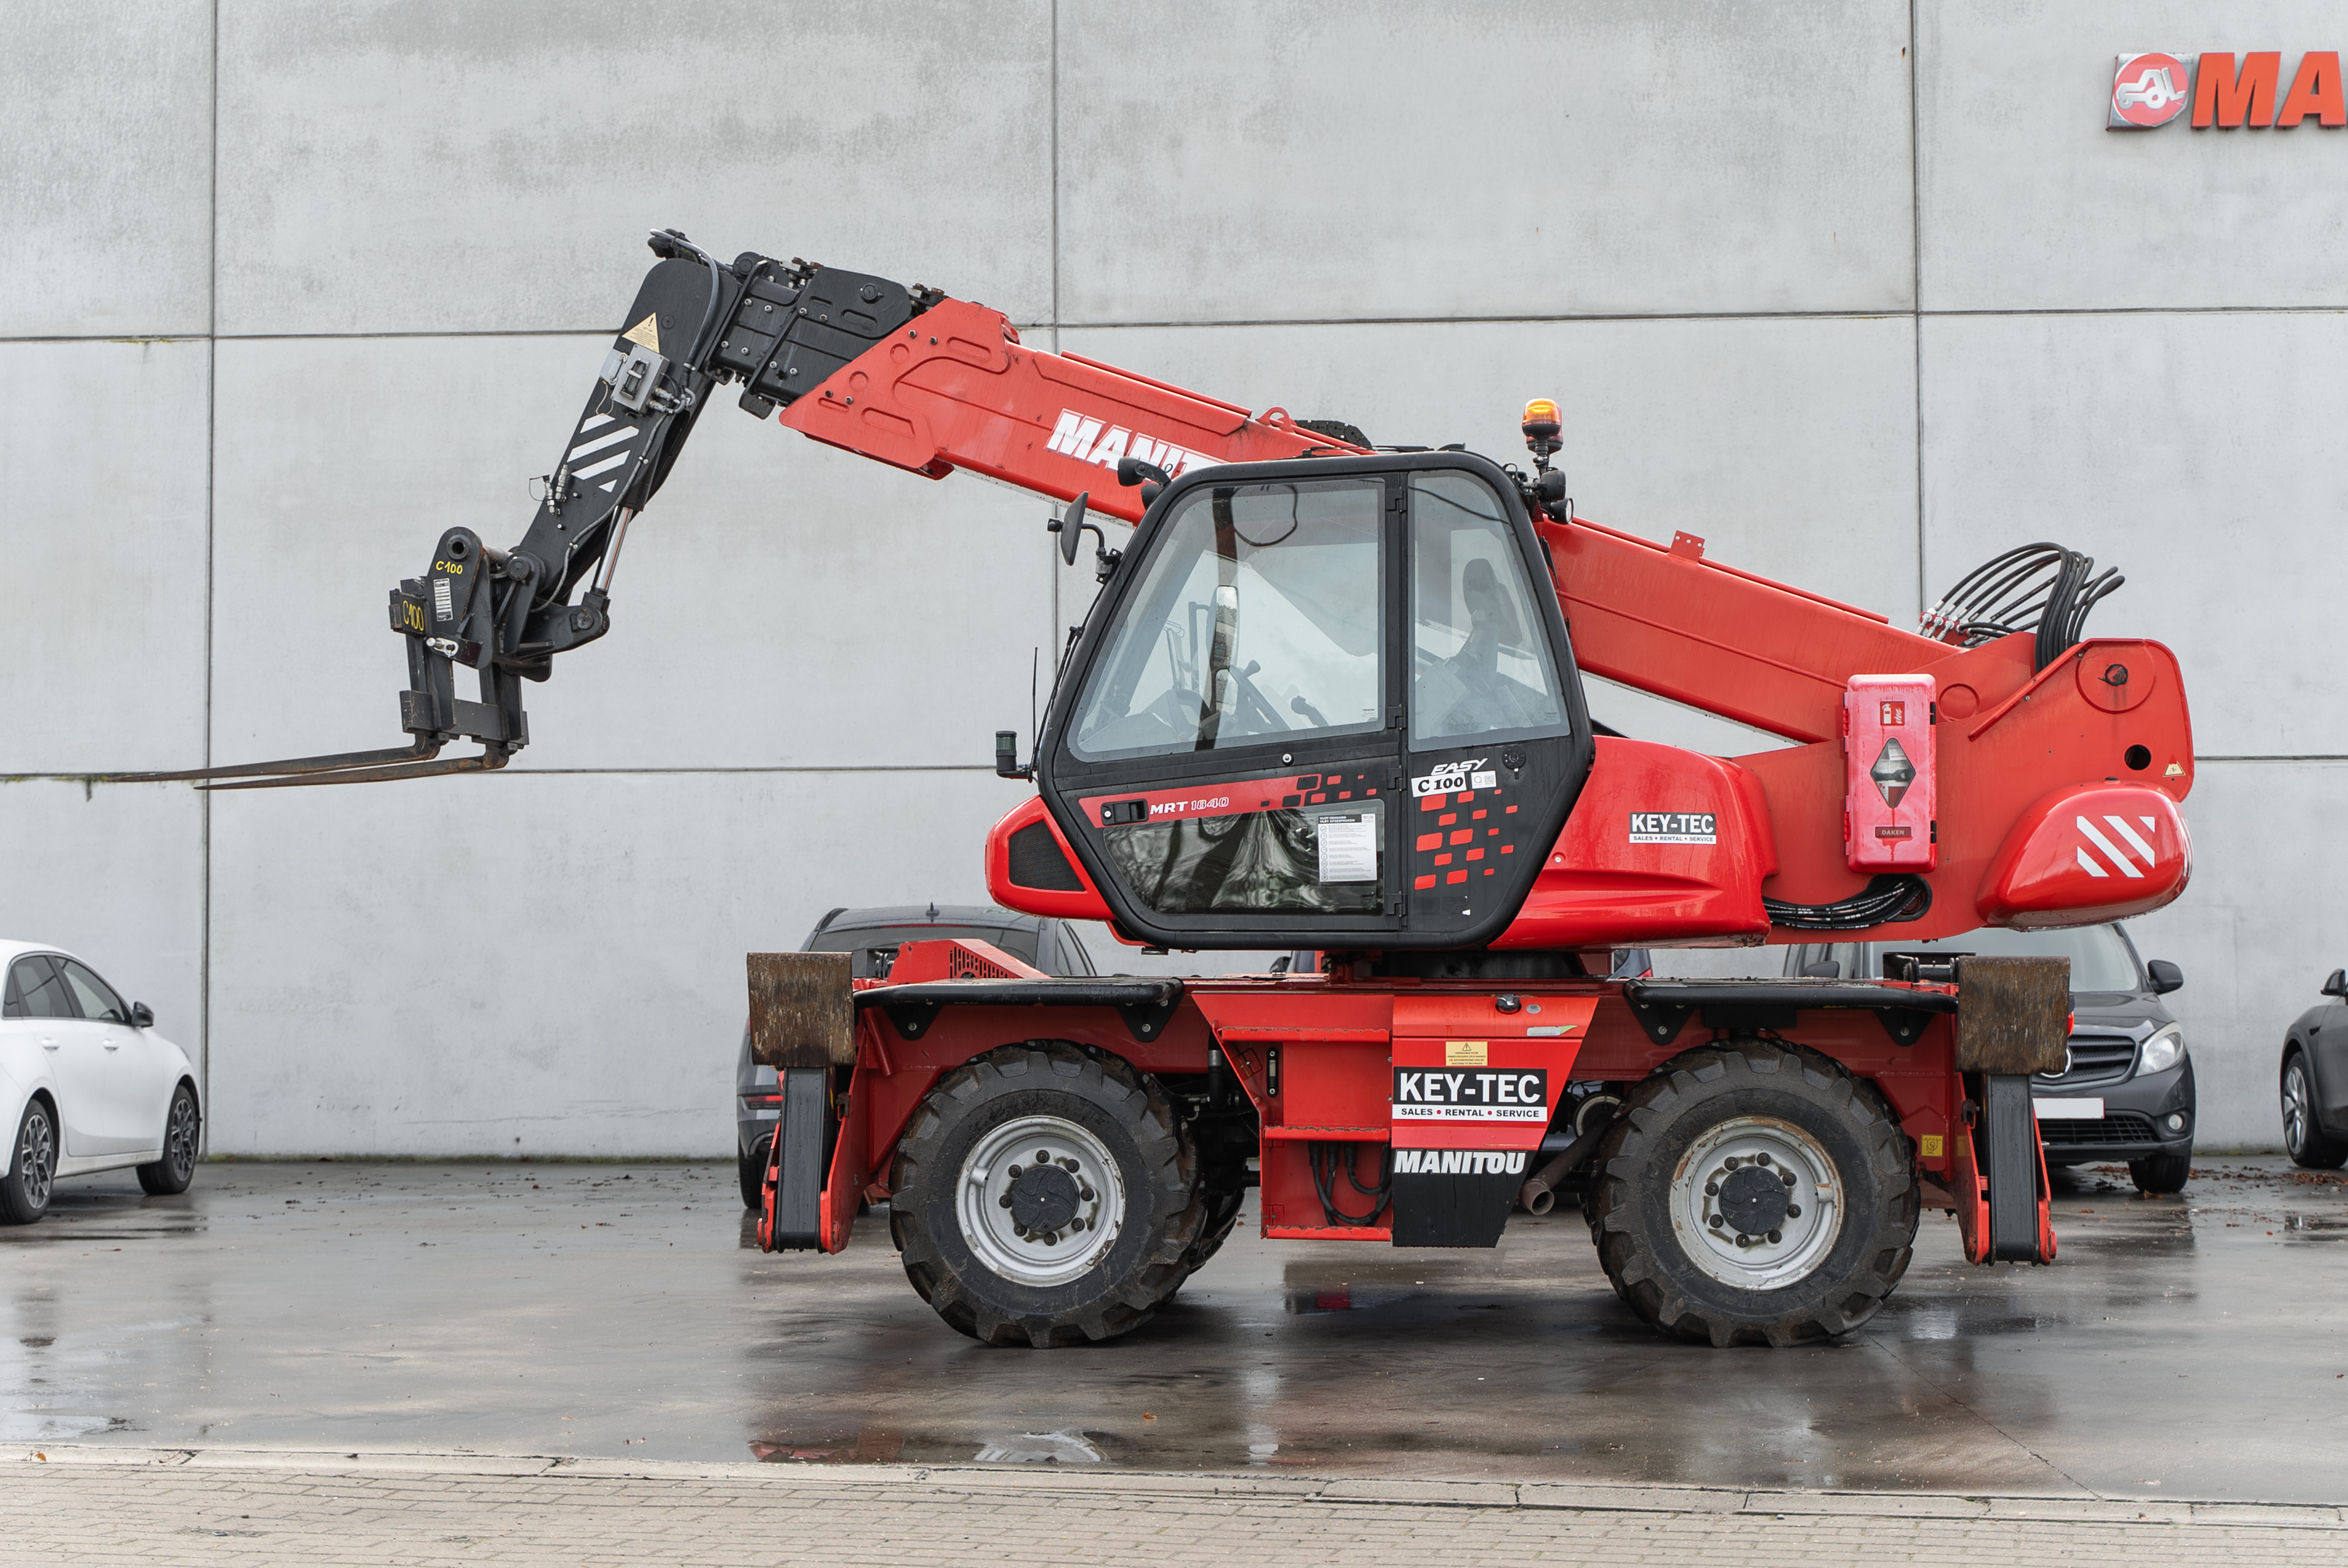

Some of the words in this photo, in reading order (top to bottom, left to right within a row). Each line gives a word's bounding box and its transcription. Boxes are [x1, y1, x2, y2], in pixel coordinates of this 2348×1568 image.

[2191, 52, 2346, 127] MA
[1431, 758, 1488, 776] EASY
[1417, 779, 1430, 792] C
[1434, 777, 1464, 790] 100
[1149, 801, 1188, 815] MRT
[1191, 797, 1229, 811] 1840
[1631, 814, 1714, 833] KEY-TEC
[1400, 1073, 1541, 1104] KEY-TEC
[1496, 1109, 1540, 1118] SERVICE
[1394, 1150, 1526, 1174] MANITOU
